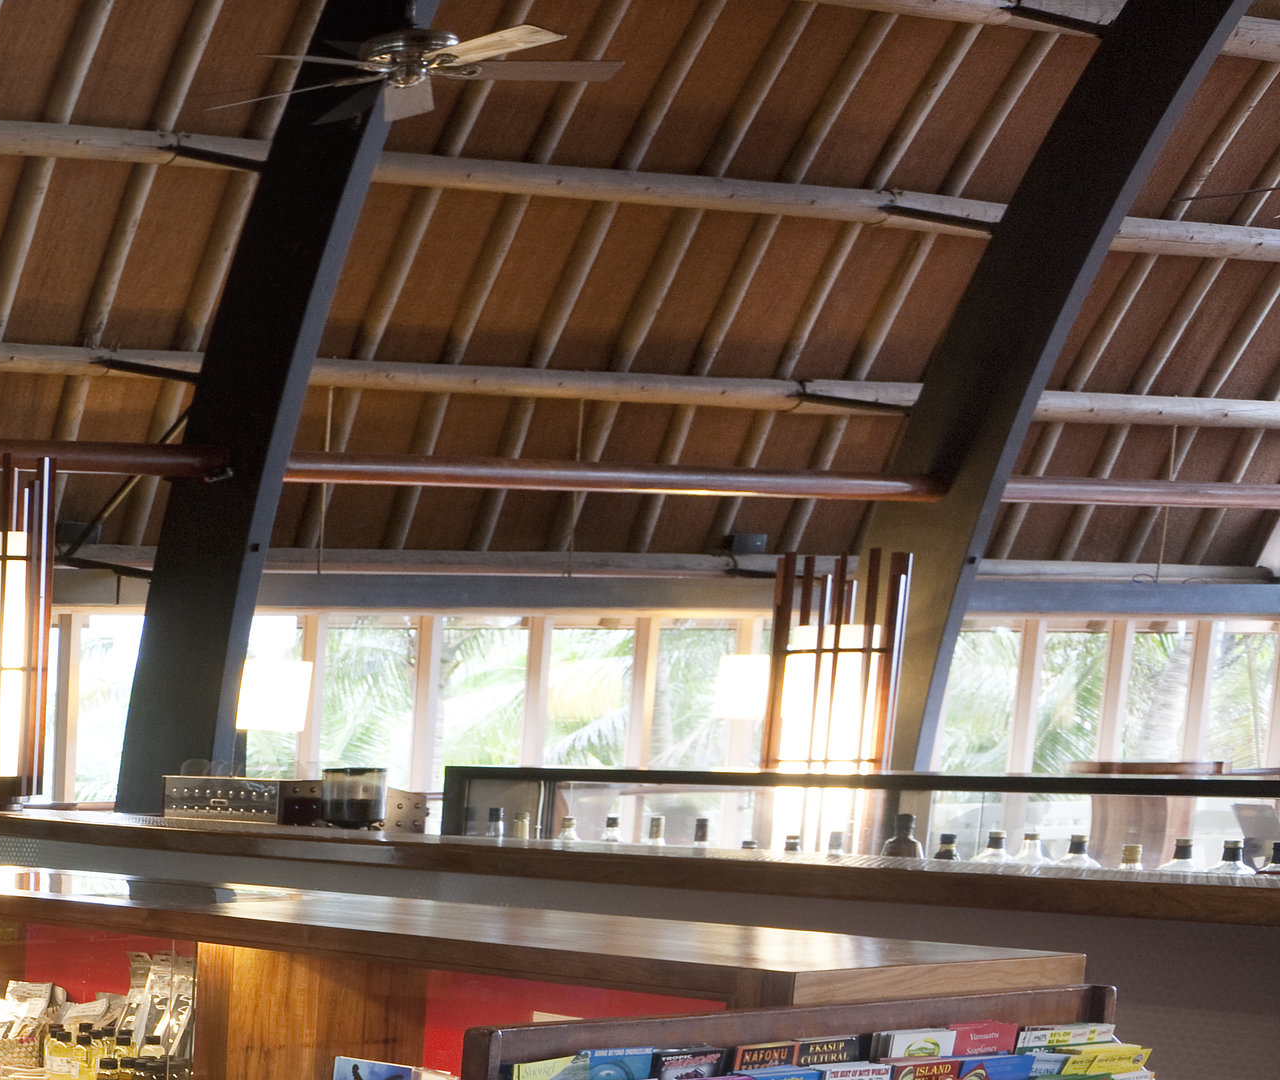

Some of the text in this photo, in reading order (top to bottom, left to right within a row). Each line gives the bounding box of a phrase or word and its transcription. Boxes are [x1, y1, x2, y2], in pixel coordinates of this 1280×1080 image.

[969, 1032, 999, 1041] Vanuatu
[809, 1042, 845, 1052] EKASUP
[743, 1048, 788, 1063] NAFONU
[801, 1052, 849, 1064] CULTURAL
[523, 1063, 555, 1079] Snorkel
[915, 1064, 952, 1077] ISLAND
